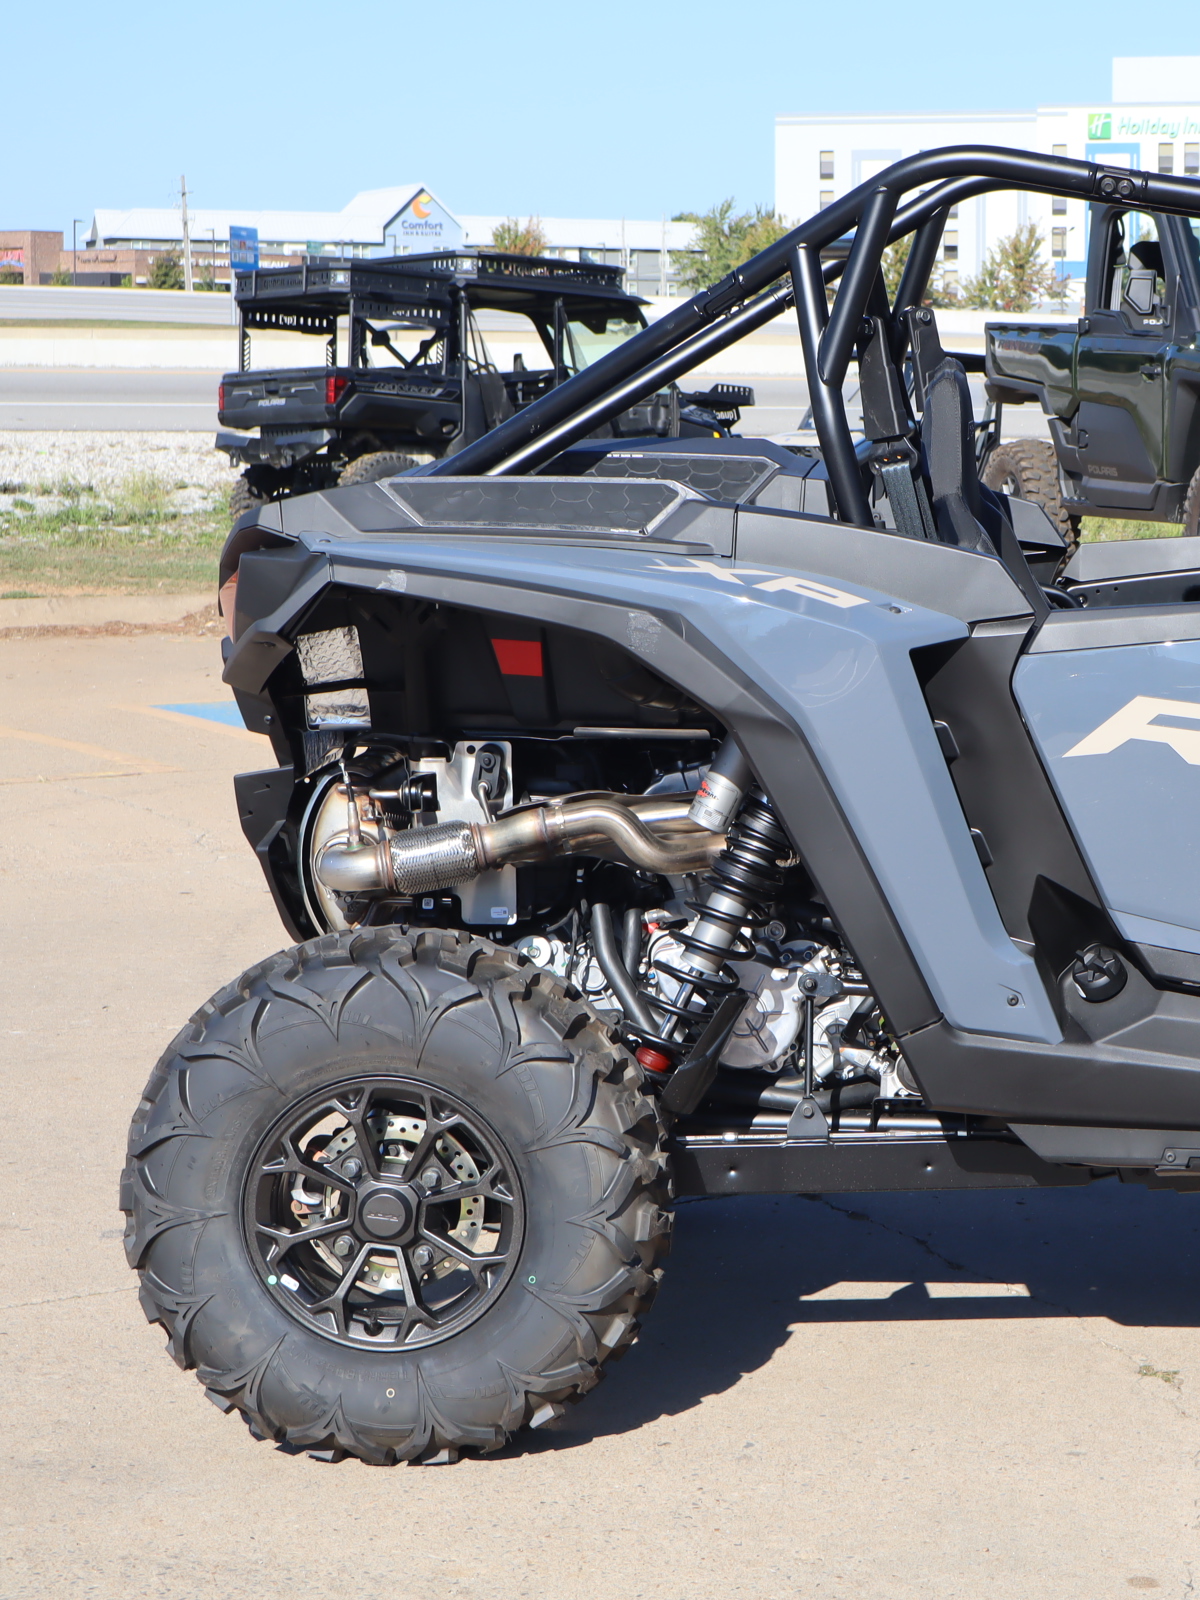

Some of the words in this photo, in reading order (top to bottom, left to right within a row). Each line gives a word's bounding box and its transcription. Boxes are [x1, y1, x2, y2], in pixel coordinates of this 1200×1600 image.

[1117, 116, 1181, 138] Holiday
[401, 220, 443, 231] Comfort
[257, 397, 287, 408] POLARIS
[1086, 464, 1119, 477] POLARIS
[646, 558, 871, 609] XP
